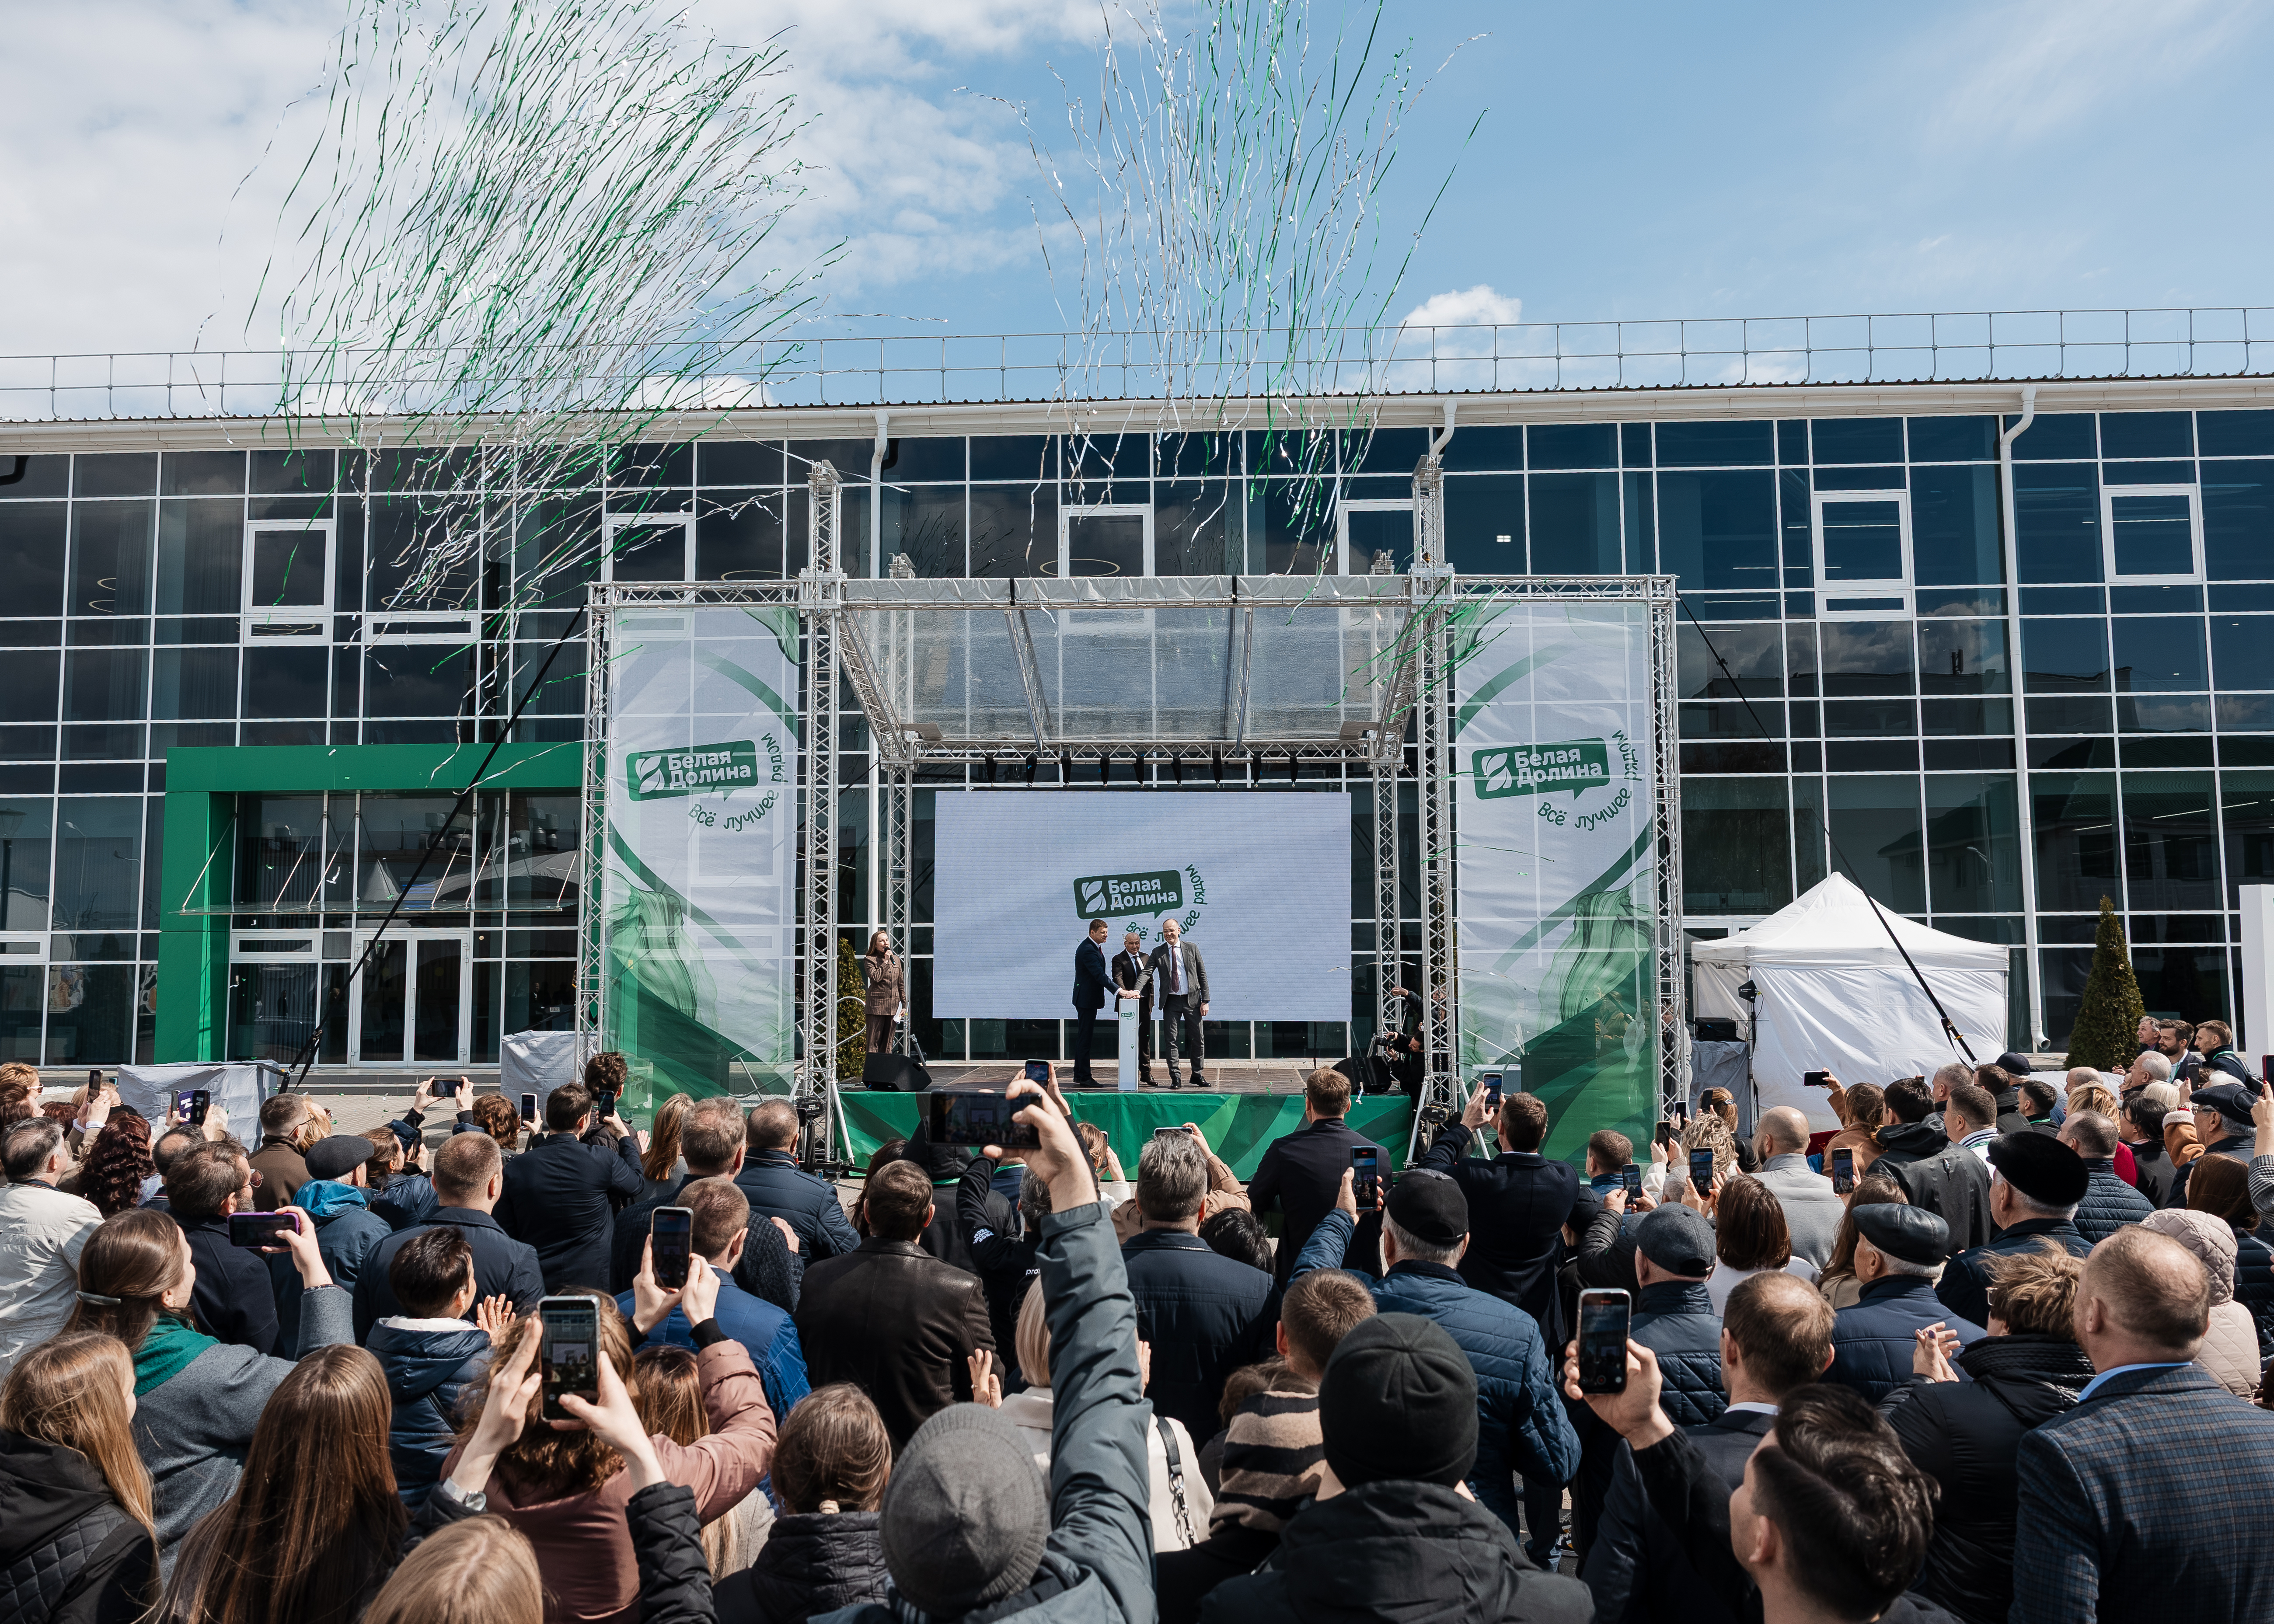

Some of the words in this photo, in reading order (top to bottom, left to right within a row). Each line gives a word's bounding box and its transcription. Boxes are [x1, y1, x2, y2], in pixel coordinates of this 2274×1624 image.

[667, 750, 731, 770] Белая
[1514, 748, 1581, 768] Белая
[669, 764, 752, 790] Долина
[688, 803, 717, 827] Всё
[723, 790, 779, 832] лучшее
[761, 732, 788, 783] рядом
[1517, 763, 1602, 788] Долина
[1537, 802, 1567, 826] Всё
[1574, 788, 1632, 831] лучшее
[1611, 730, 1642, 781] рядом
[1108, 879, 1161, 894] Белая
[1185, 864, 1208, 905] рядом
[1110, 891, 1178, 911] Долина
